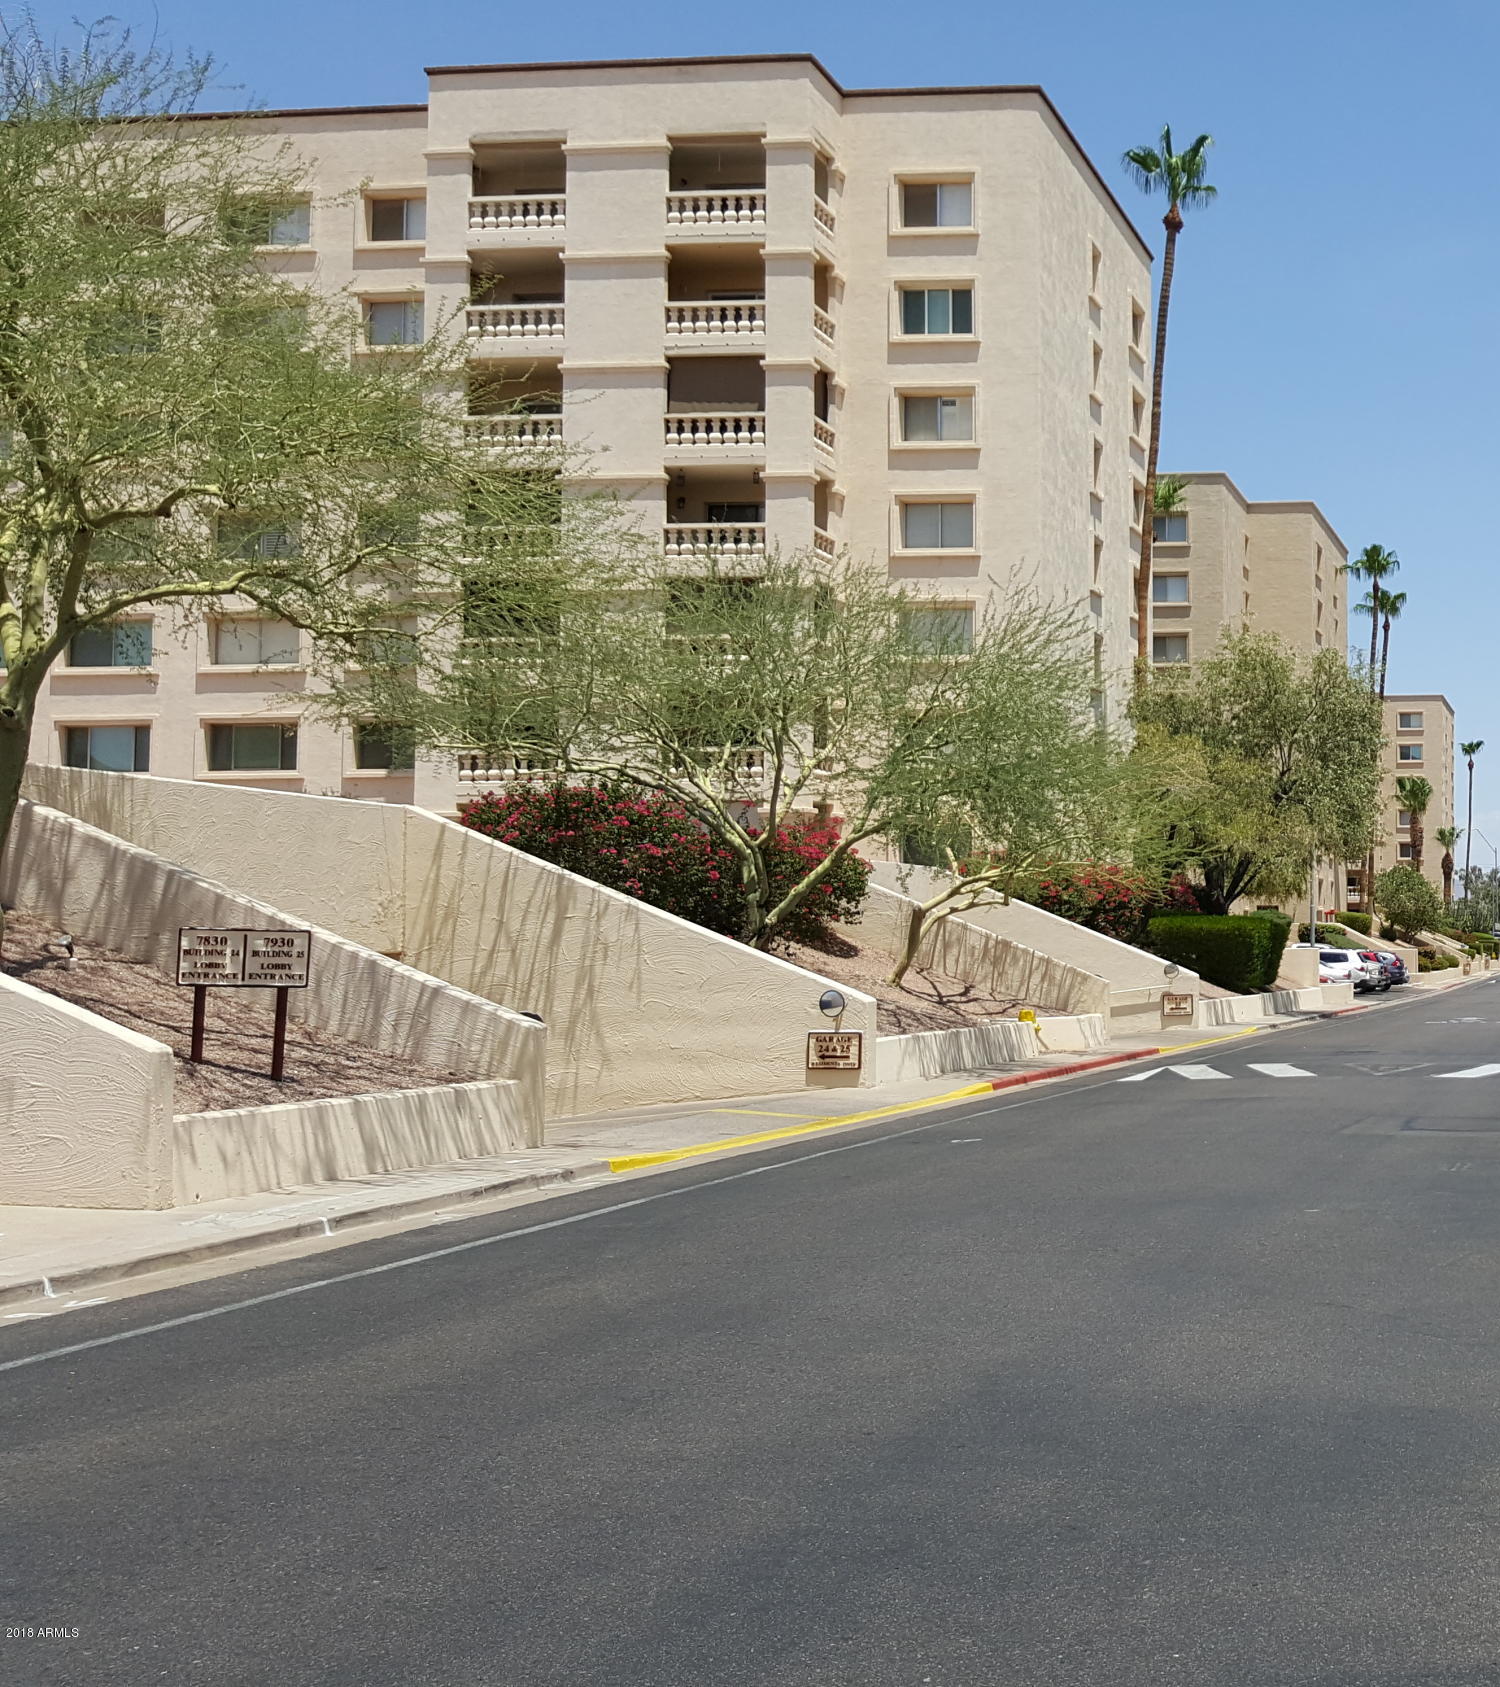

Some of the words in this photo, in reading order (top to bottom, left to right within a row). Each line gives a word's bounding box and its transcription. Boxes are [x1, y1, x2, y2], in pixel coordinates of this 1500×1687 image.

[196, 935, 228, 946] 7830
[263, 937, 295, 948] 7930
[183, 948, 227, 956] BUILDING
[251, 950, 293, 958] BUILDING
[193, 961, 227, 969] LOBBY
[181, 971, 239, 980] ENTRANCE
[248, 972, 305, 981] ENTRANCE
[815, 1035, 852, 1043] GARAGE
[818, 1044, 830, 1053] 24
[840, 1044, 851, 1054] 25
